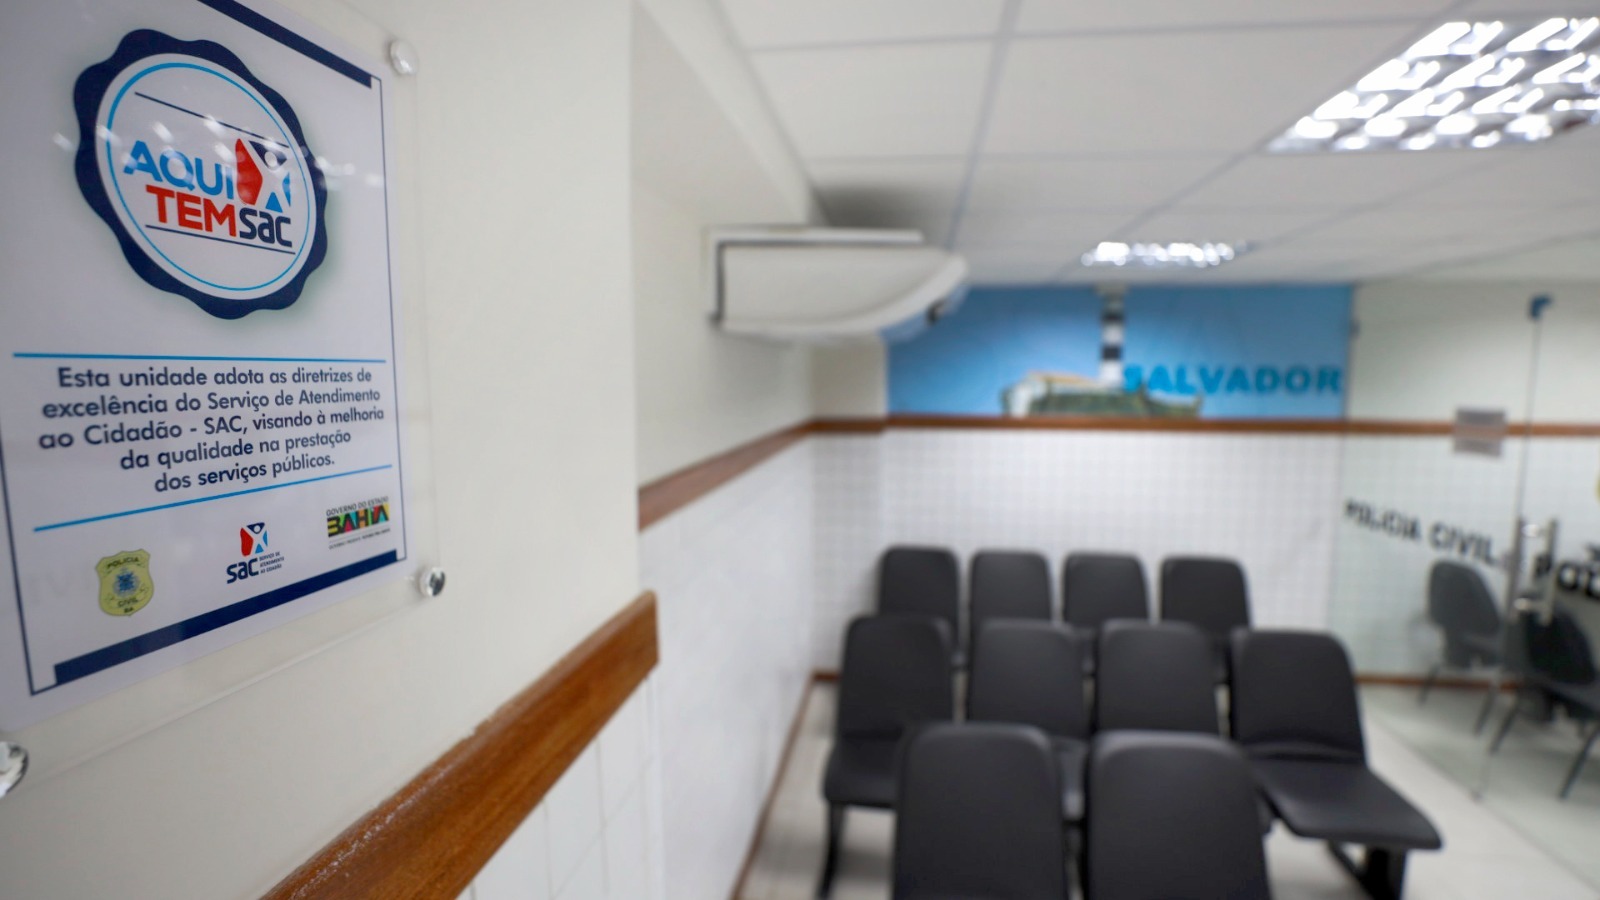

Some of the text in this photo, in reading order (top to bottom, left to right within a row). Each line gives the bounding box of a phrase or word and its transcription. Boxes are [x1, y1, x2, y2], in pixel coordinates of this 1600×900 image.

[122, 139, 234, 200] AQUI
[145, 184, 237, 237] TEM
[58, 366, 372, 388] Esta unidade adota as diretrizes de
[1123, 364, 1343, 394] SALVADOR
[42, 387, 381, 418] excelência do Serviço de Atendimento
[38, 432, 74, 449] ao
[84, 420, 182, 445] Cidadão
[203, 415, 248, 435] SAC,
[252, 410, 313, 431] visando
[316, 409, 326, 425] à
[330, 405, 384, 424] melhoria
[120, 430, 351, 470] da qualidade na prestação
[154, 453, 335, 492] dos serviços públicos.
[327, 504, 390, 538] BAHIA
